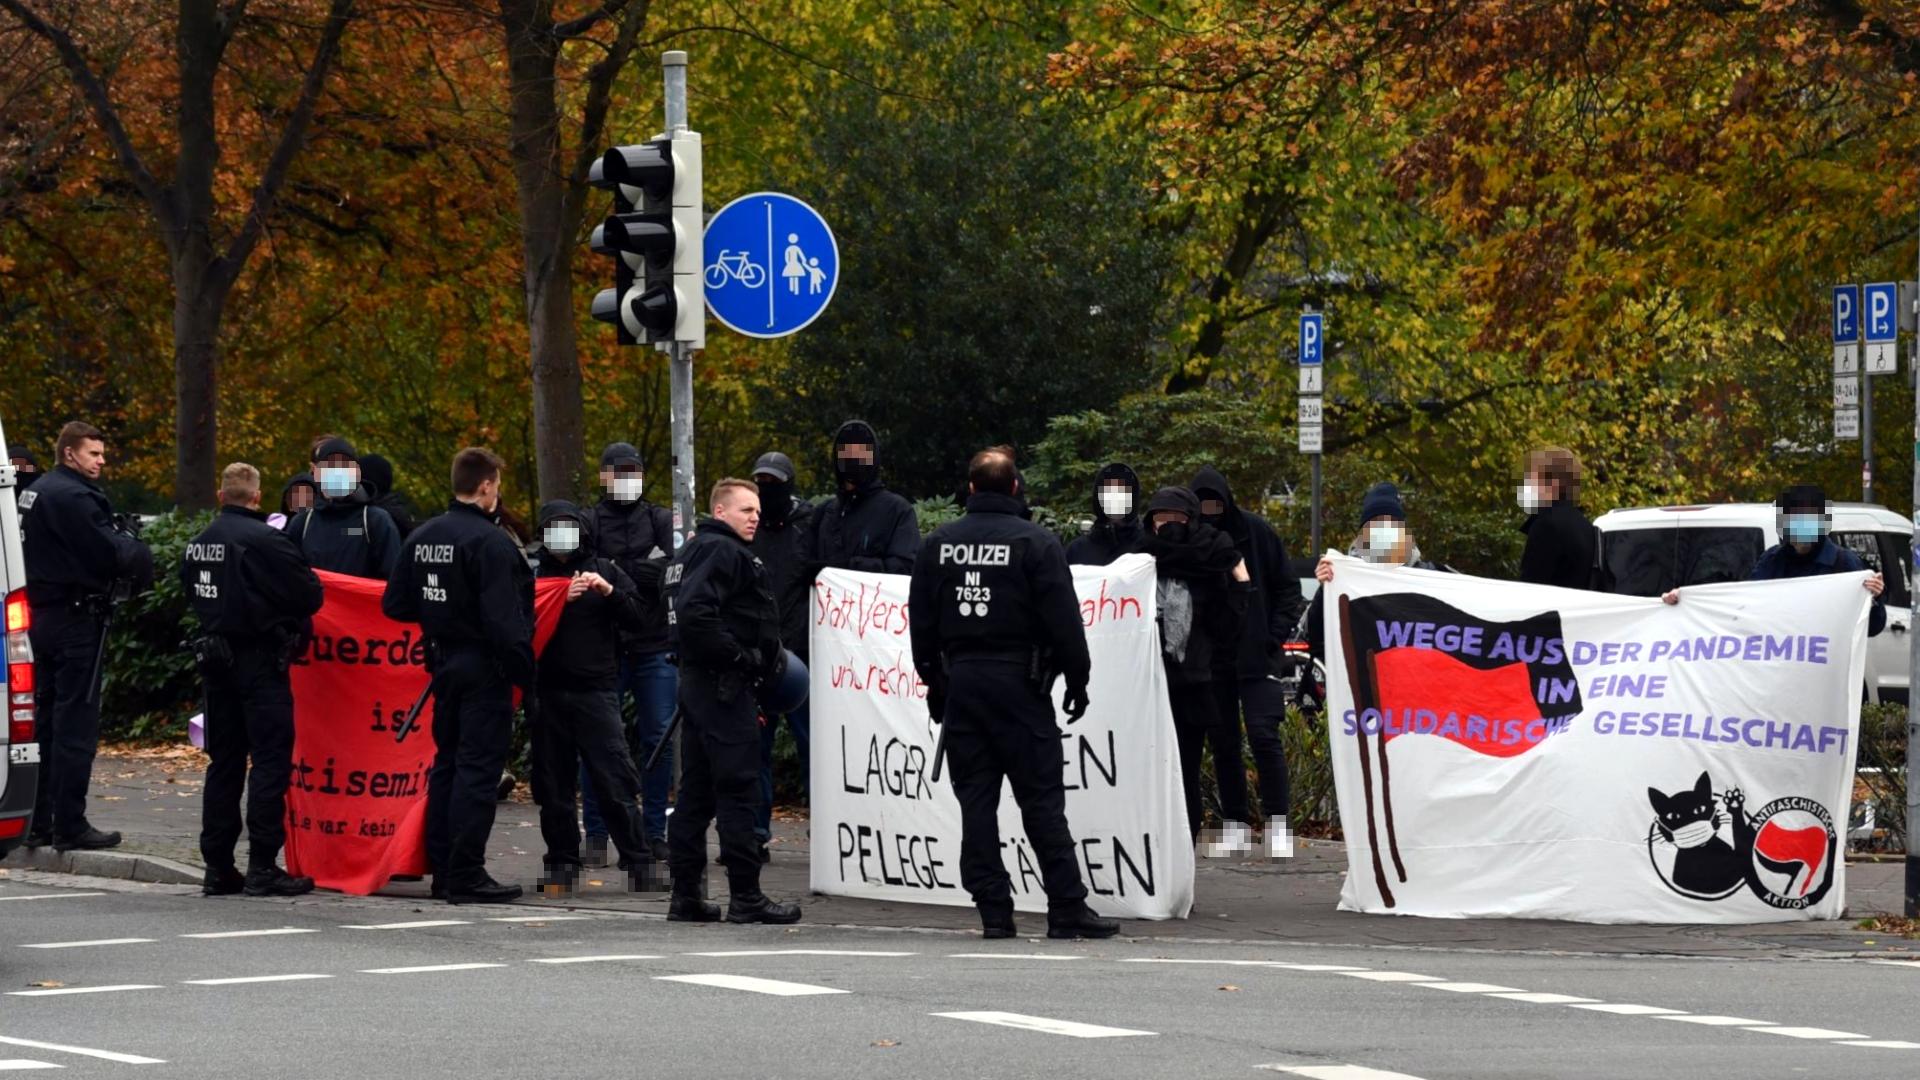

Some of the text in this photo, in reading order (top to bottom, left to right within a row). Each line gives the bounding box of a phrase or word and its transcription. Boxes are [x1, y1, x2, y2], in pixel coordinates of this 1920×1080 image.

[1837, 292, 1851, 336] P
[1871, 290, 1890, 334] P
[1304, 321, 1317, 358] P
[185, 543, 226, 562] POLIZEI
[414, 544, 454, 563] POLIZEI
[939, 544, 1010, 566] POLIZEI
[200, 570, 211, 584] NI
[427, 573, 438, 587] NI
[965, 571, 980, 586] NI
[193, 583, 218, 599] 7623
[422, 586, 447, 602] 7623
[955, 586, 991, 602] 7623
[858, 581, 909, 640] Vers
[1081, 579, 1141, 626] ahn
[1376, 620, 1829, 666] WEGE AUS DER PANDEMIE
[1537, 674, 1668, 704] IN EINE
[1342, 706, 1849, 755] SOLIDARISCHE GESELLSCHAFT
[1763, 892, 1810, 909] AKTION
